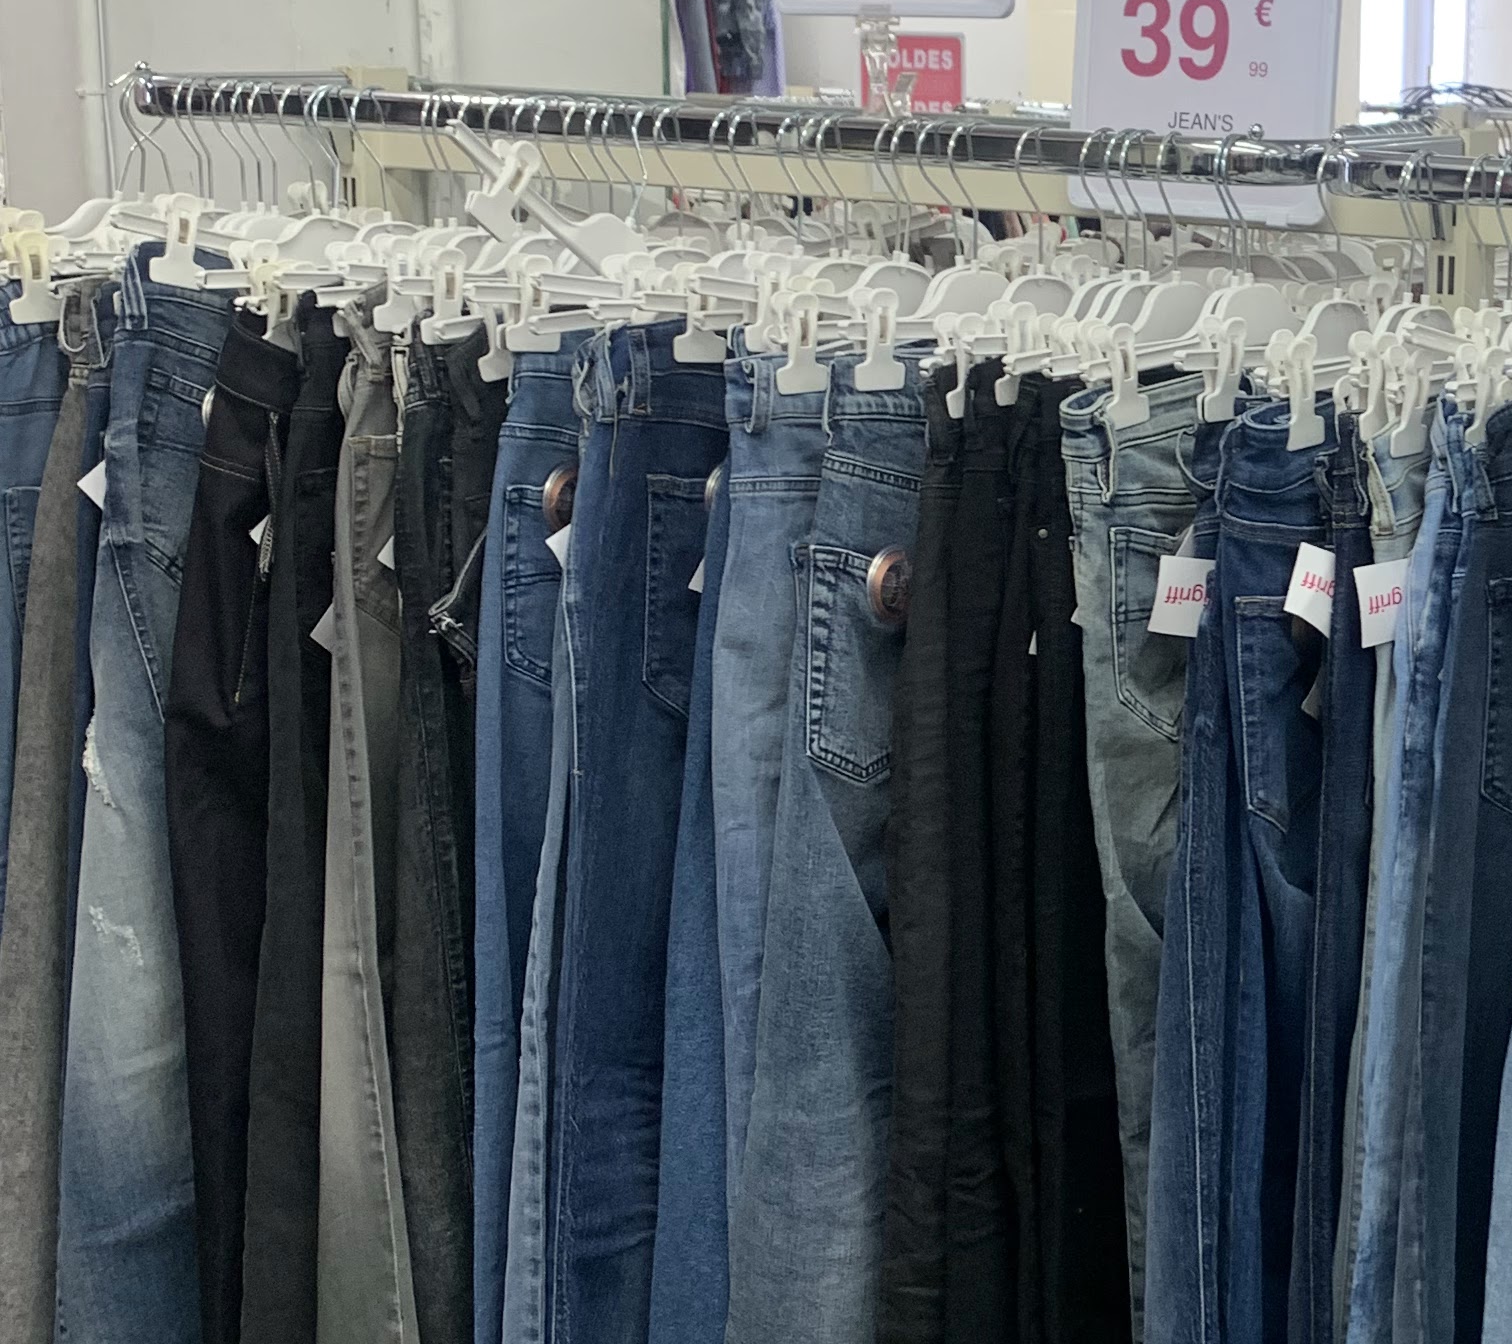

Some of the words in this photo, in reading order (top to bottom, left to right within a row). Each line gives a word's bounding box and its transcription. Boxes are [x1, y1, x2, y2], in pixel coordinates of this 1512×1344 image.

[888, 48, 954, 71] OLDES
[1248, 61, 1268, 77] 99
[1167, 110, 1234, 133] JEAN'S
[1164, 583, 1206, 605] griff
[1300, 571, 1335, 599] griff
[1368, 586, 1403, 615] griff
